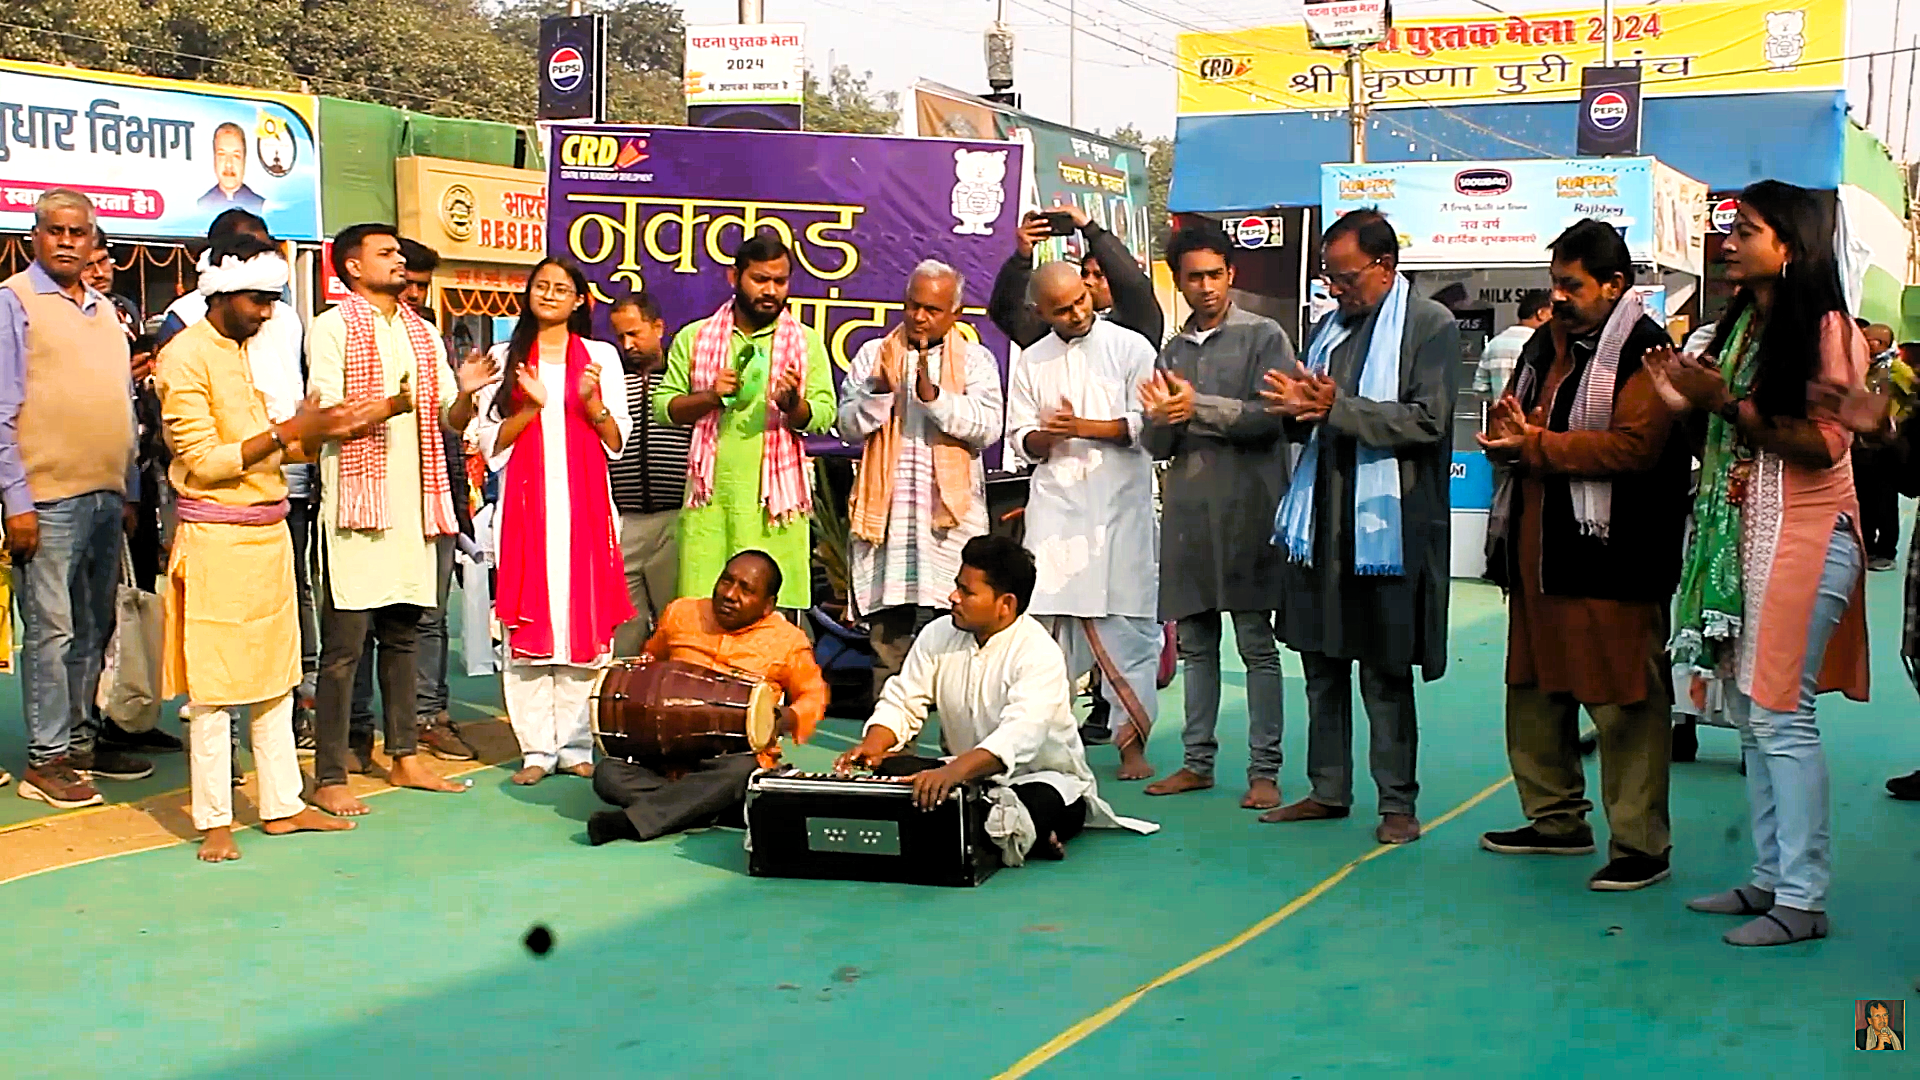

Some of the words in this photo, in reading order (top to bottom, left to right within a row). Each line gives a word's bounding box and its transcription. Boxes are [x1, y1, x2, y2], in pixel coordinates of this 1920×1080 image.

[691, 36, 725, 49] पटना
[729, 35, 768, 51] पुस्तक
[770, 32, 799, 47] मेला
[1405, 23, 1499, 59] पुस्तक
[1504, 16, 1578, 47] मेला
[551, 64, 581, 75] PEPSI
[727, 58, 764, 71] 2024
[1200, 57, 1234, 79] CRD
[1362, 66, 1479, 99] कृष्णा
[1494, 54, 1573, 94] पुरी
[1593, 106, 1625, 115] PEPSI
[85, 98, 195, 162] विभाग
[561, 134, 619, 167] CRD
[1339, 178, 1396, 192] HAPPY
[1556, 175, 1619, 190] HAPPY
[1460, 219, 1479, 230] नव
[1482, 216, 1501, 230] वर्ष
[478, 217, 543, 252] RESER
[1479, 287, 1512, 304] MILK
